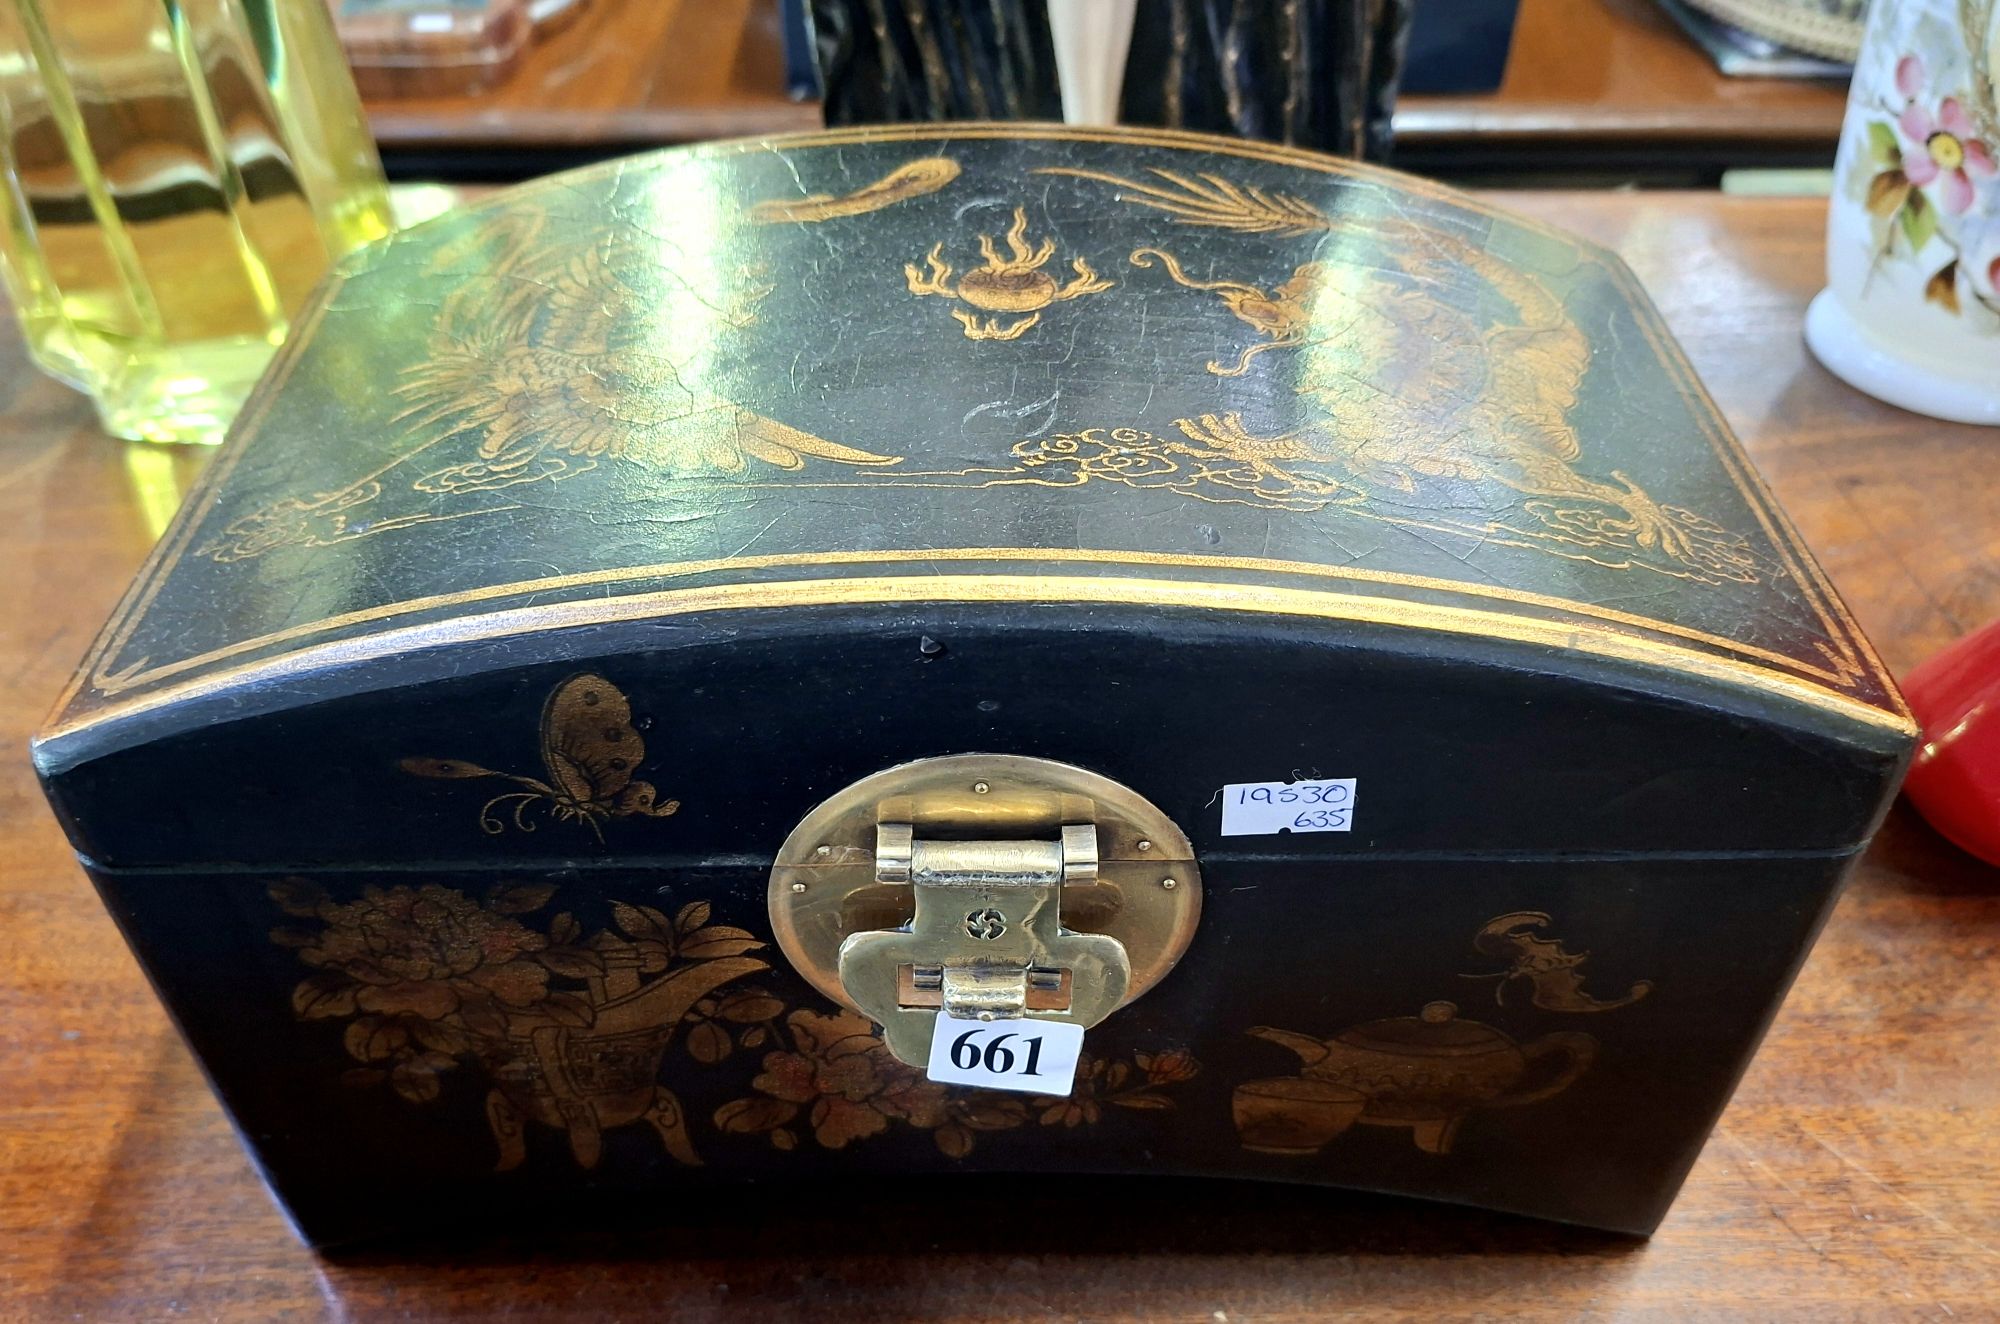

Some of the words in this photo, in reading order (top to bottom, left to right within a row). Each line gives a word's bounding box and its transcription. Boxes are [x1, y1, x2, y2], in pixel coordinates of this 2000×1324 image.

[1240, 784, 1348, 805] 19530
[1294, 808, 1353, 828] 635
[950, 1029, 1043, 1076] 661
